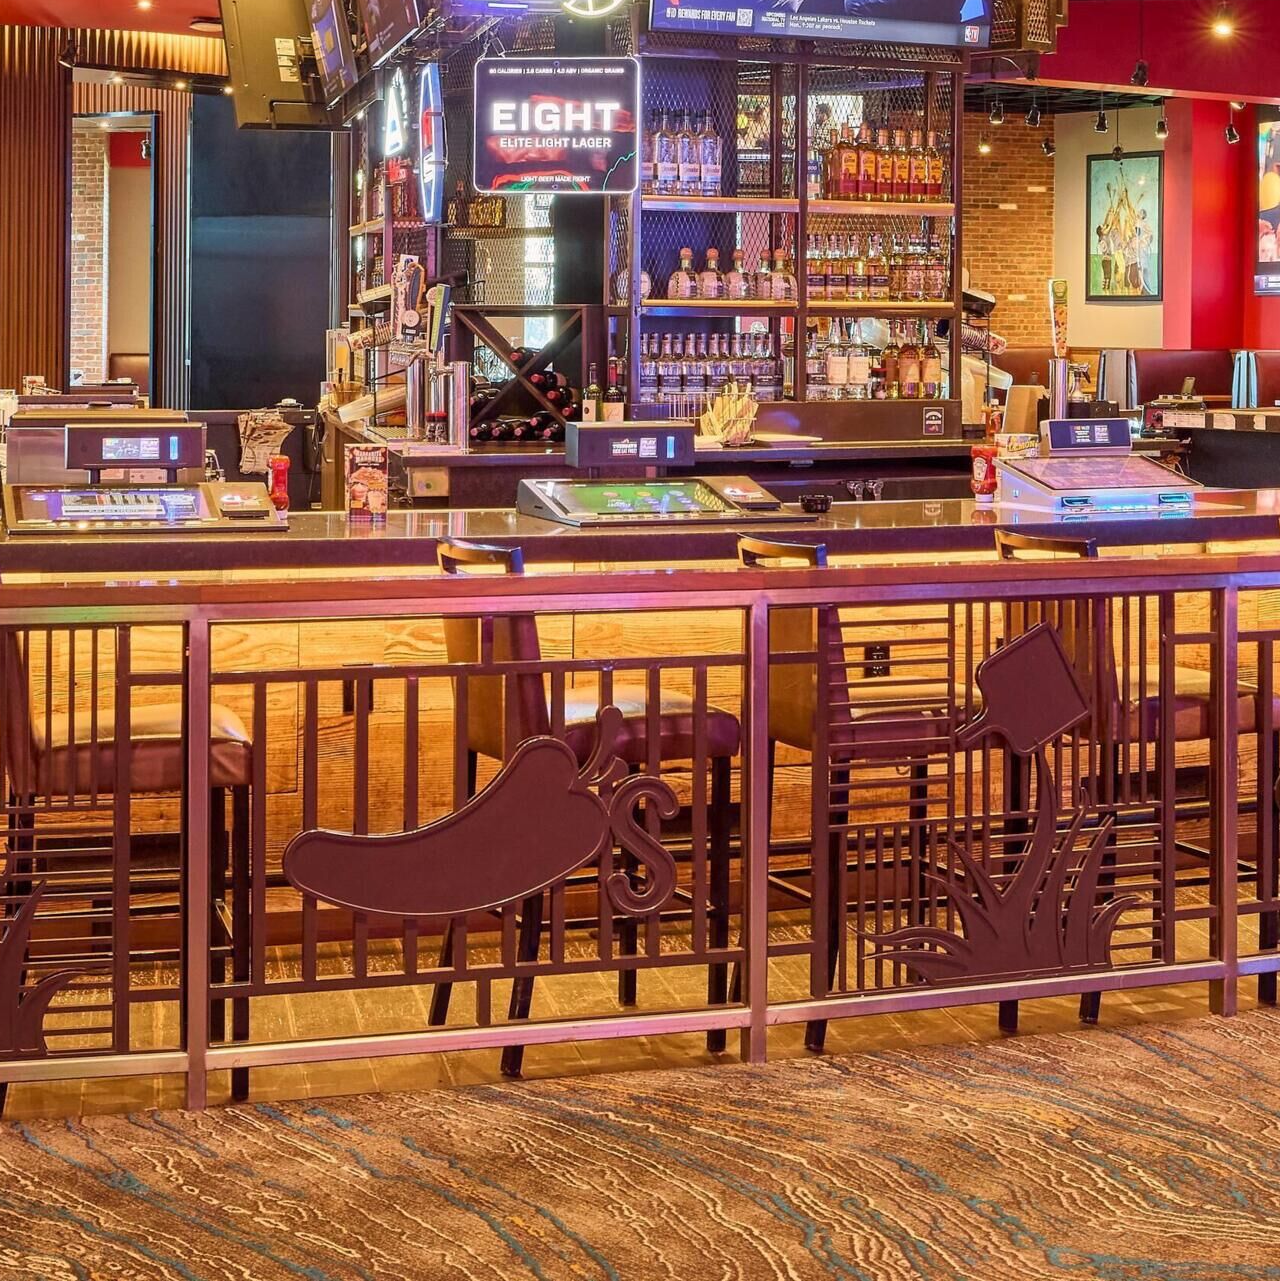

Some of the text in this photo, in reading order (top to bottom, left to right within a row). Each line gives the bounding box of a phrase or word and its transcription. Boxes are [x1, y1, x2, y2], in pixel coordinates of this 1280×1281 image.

[701, 10, 711, 20] FOR
[711, 11, 725, 21] EVERY
[799, 15, 816, 23] Angeles
[492, 102, 620, 132] EIGHT
[500, 138, 611, 148] ELITE LIGHT LAGER
